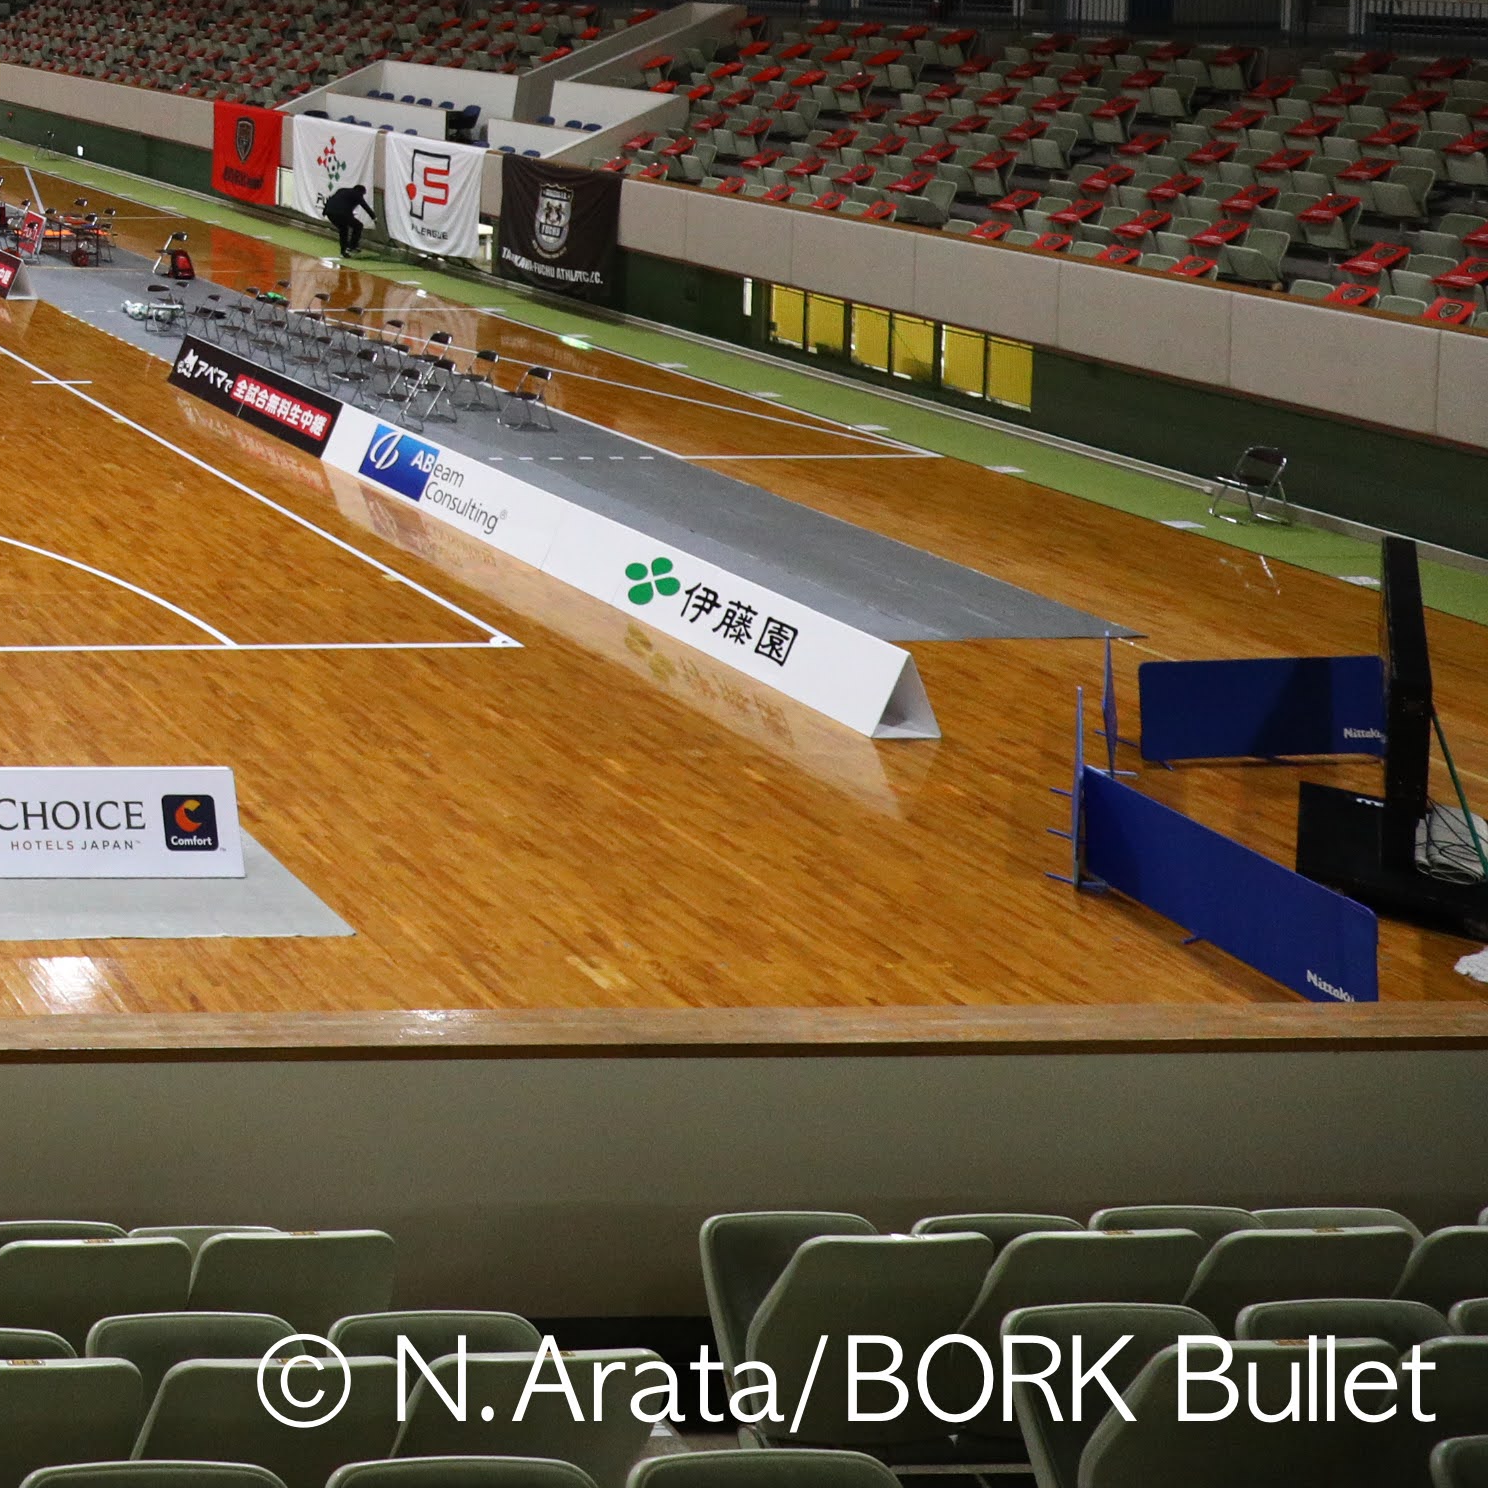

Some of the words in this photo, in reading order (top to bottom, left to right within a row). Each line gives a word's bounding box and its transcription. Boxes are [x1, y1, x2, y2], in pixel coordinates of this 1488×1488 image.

[194, 360, 234, 394] アベマで
[233, 379, 328, 436] 全試合無料生中継
[411, 448, 465, 490] ABeam
[424, 480, 499, 535] Consulting
[680, 580, 799, 668] 伊藤園
[10, 840, 75, 850] HOTELS
[80, 841, 134, 850] JAPAN
[170, 834, 212, 847] Comfort
